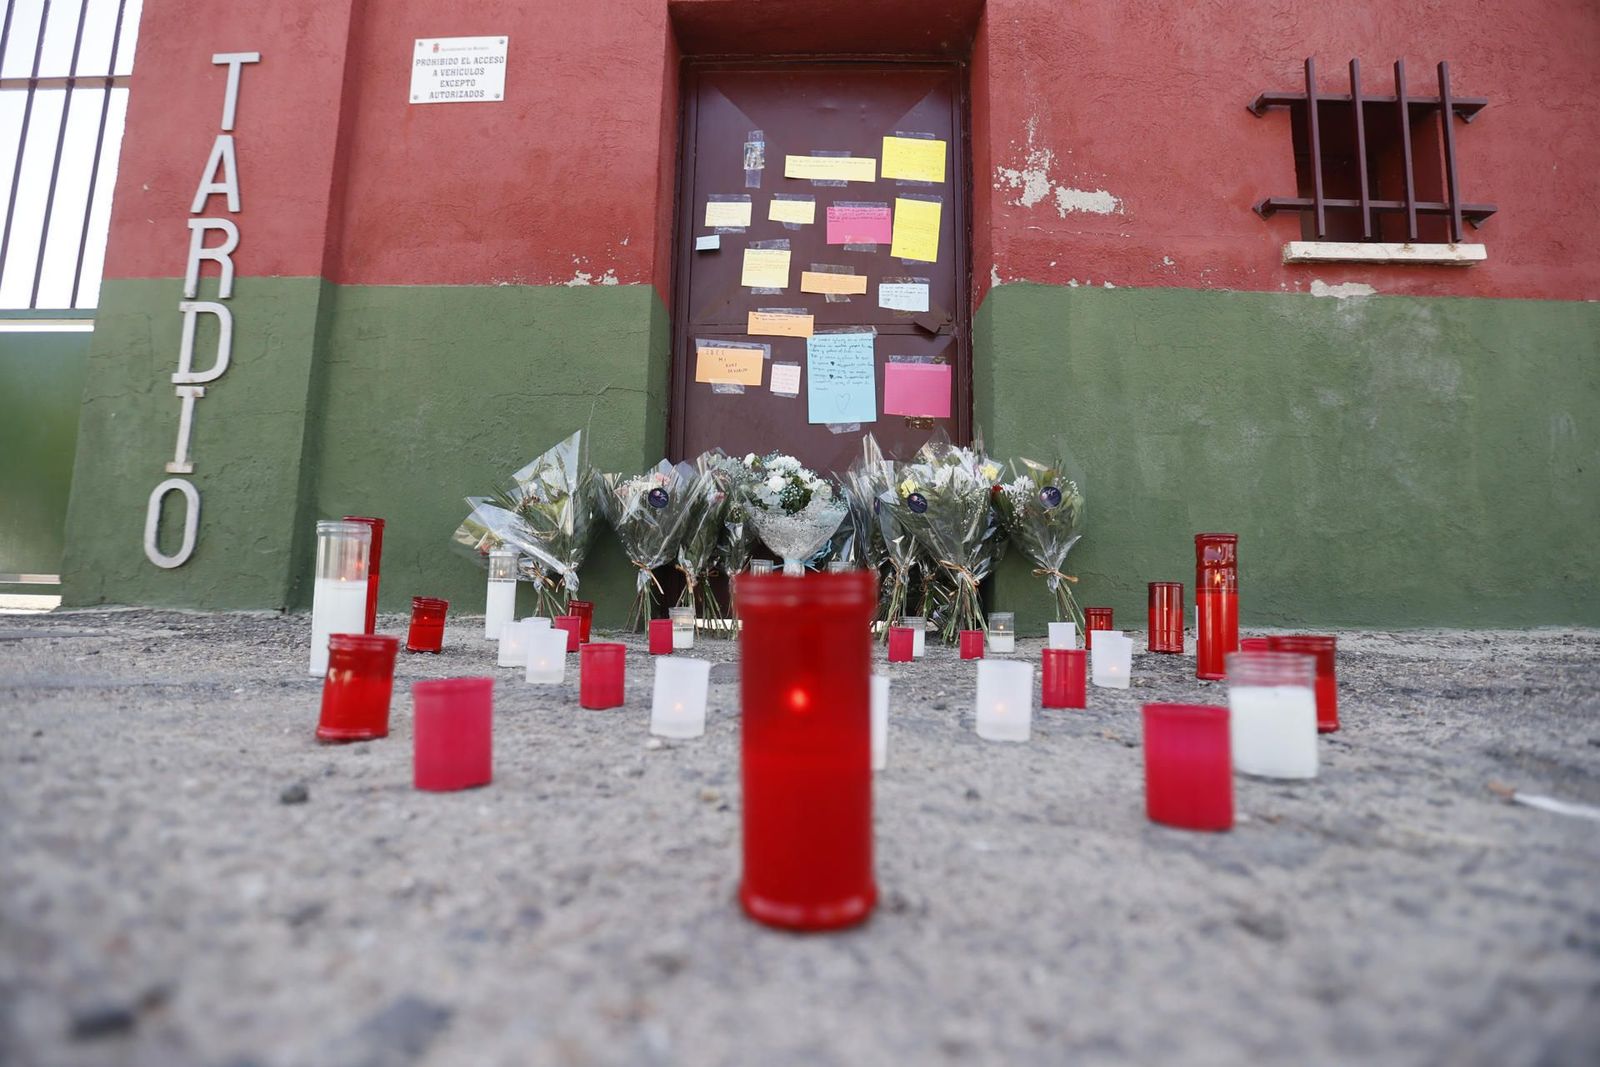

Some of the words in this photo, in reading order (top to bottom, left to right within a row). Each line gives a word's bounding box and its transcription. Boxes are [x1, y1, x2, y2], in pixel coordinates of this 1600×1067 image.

[415, 57, 459, 67] PROHIBIDO
[461, 56, 471, 65] EL
[473, 55, 505, 65] ACCESO
[432, 69, 438, 77] A
[440, 78, 476, 88] EXCEPTO
[429, 89, 485, 99] AUTORIZADOS
[144, 51, 261, 569] TARDIO
